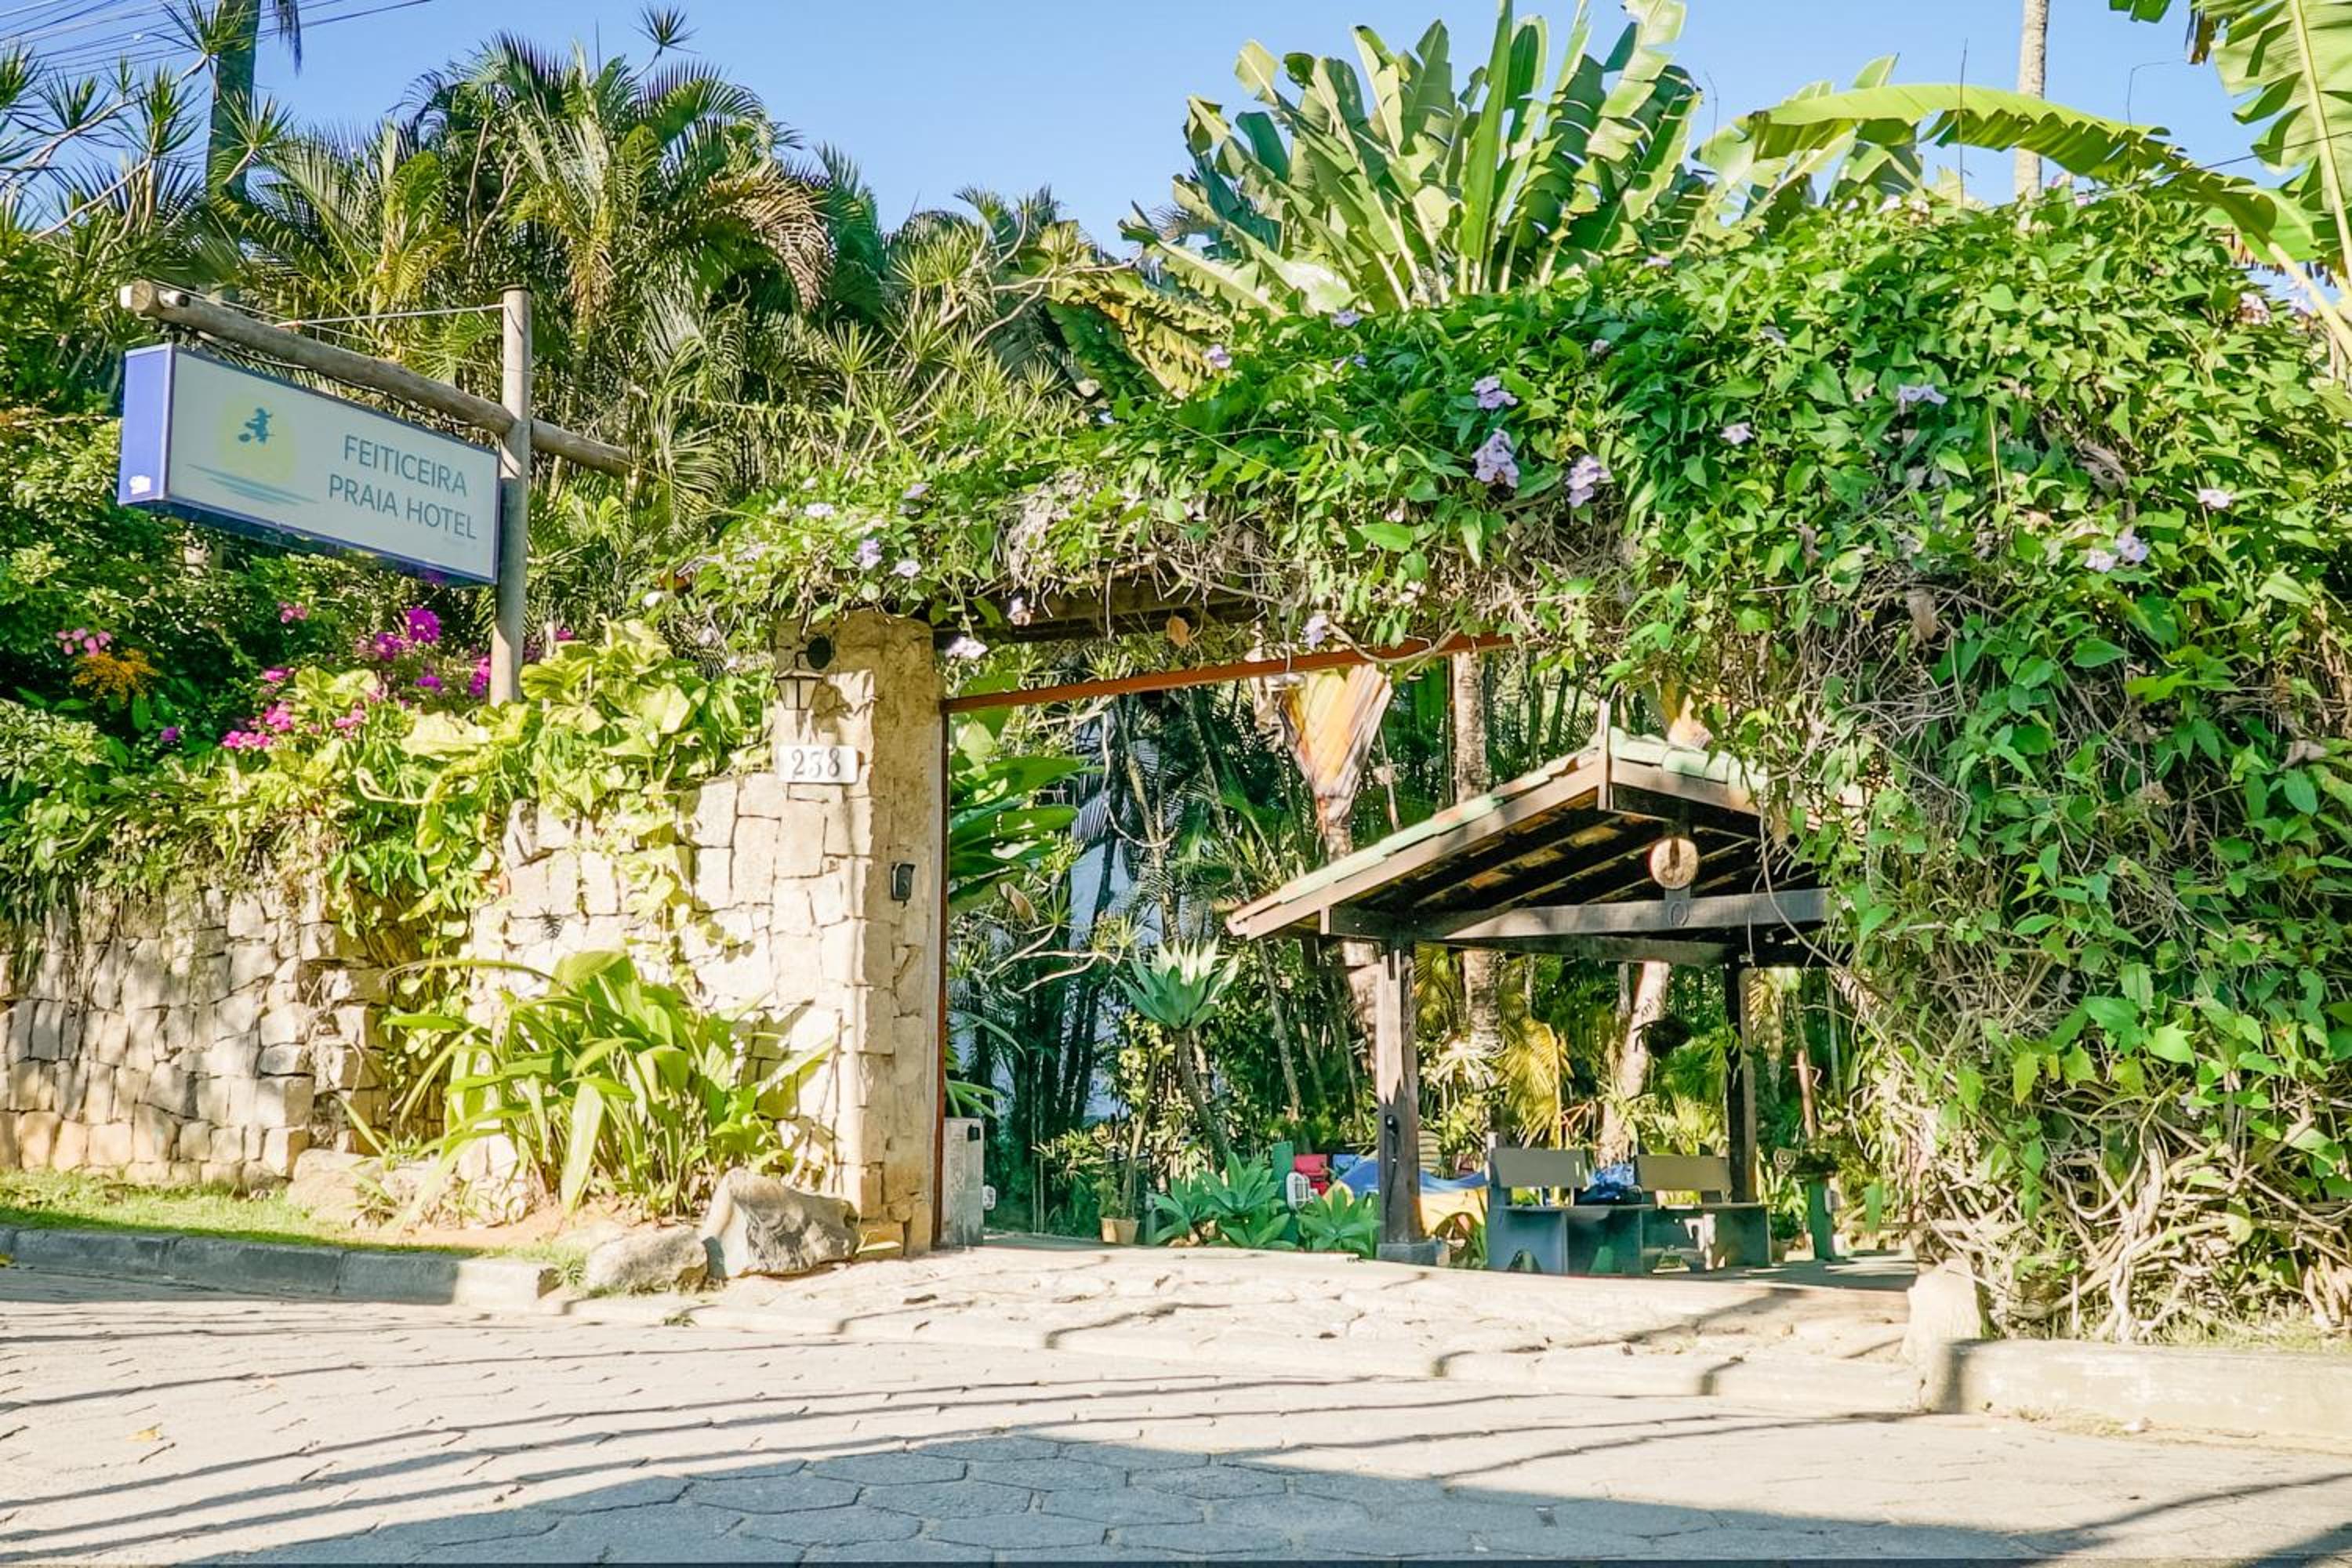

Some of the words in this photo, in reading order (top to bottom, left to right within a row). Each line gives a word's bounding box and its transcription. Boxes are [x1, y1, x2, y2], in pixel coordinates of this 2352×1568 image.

[343, 434, 468, 498] FEITICEIRA
[328, 473, 399, 517] PRAIA
[406, 495, 477, 540] HOTEL
[791, 746, 841, 779] 238
